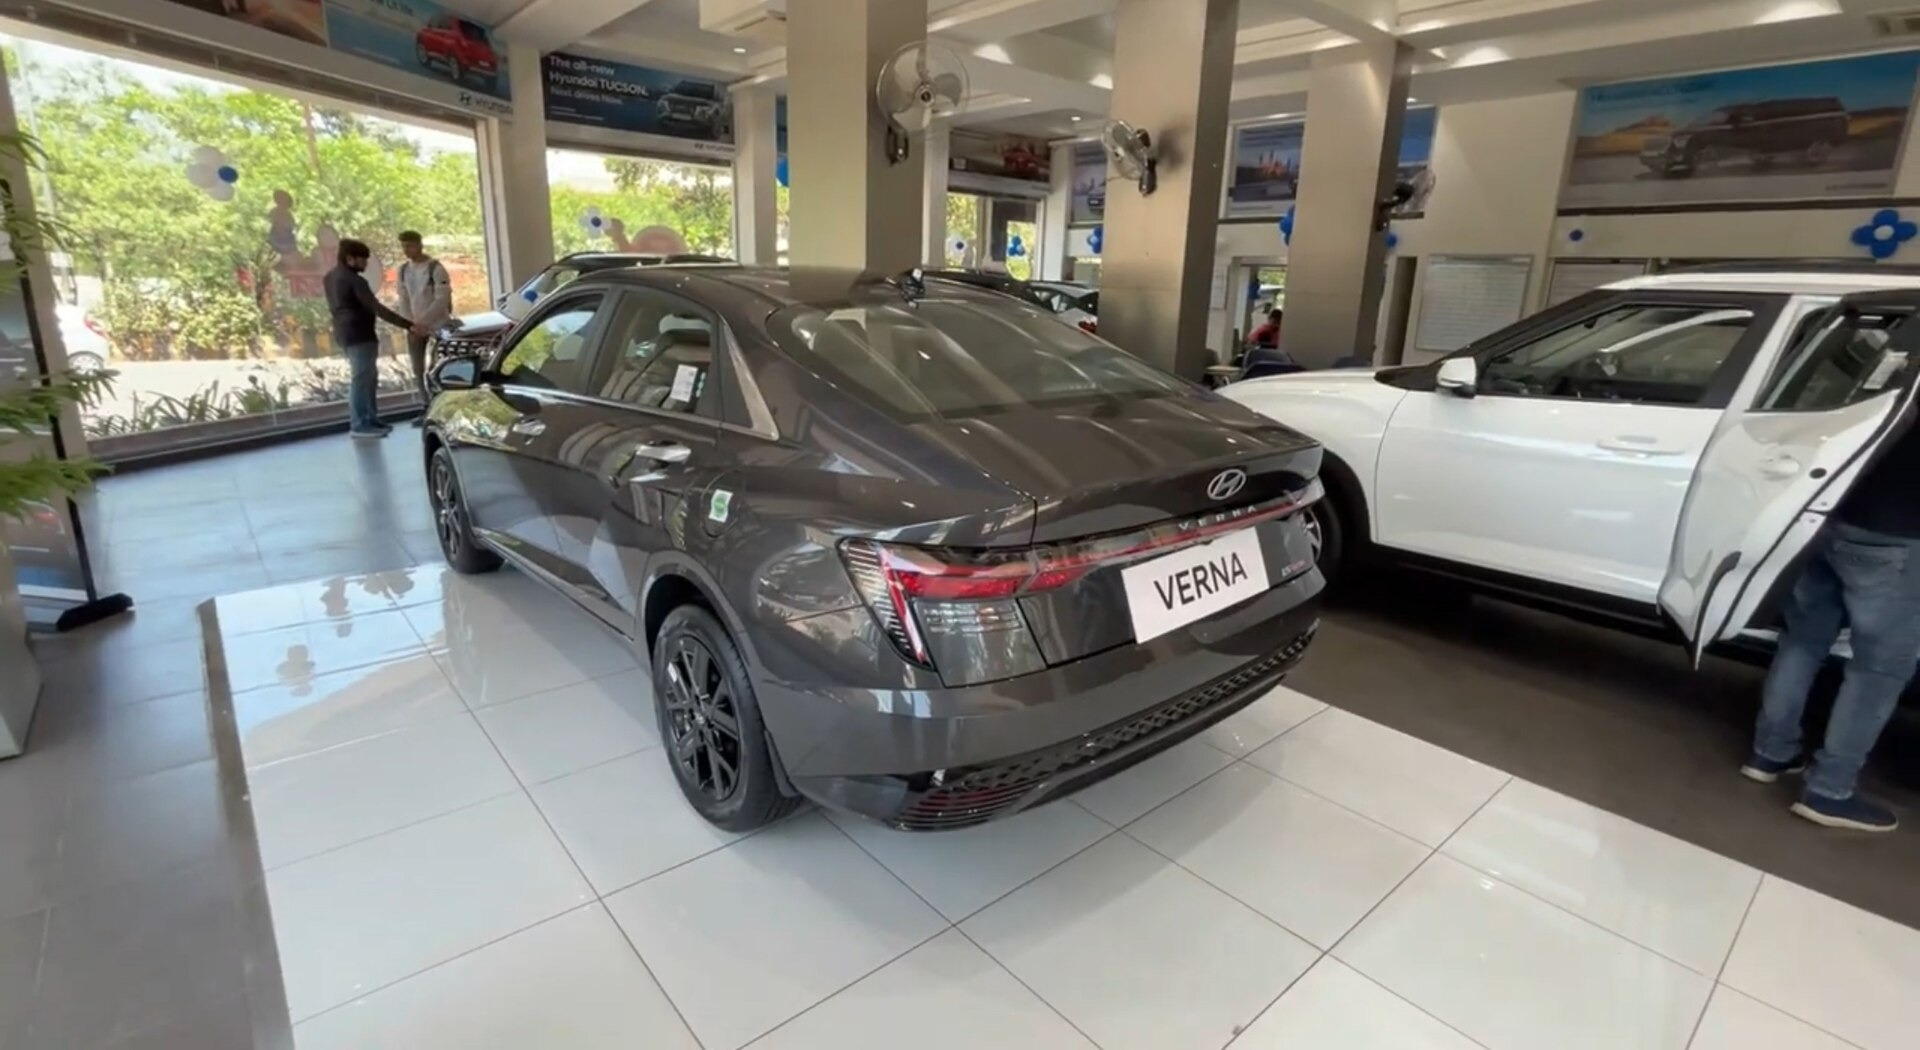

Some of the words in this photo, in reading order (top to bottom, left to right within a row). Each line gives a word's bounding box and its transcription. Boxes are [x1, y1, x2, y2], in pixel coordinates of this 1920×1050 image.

[551, 56, 570, 67] The
[573, 60, 615, 75] all-new
[549, 71, 598, 88] Hyundai
[1178, 505, 1257, 530] VERNA
[1153, 551, 1248, 611] VERNA
